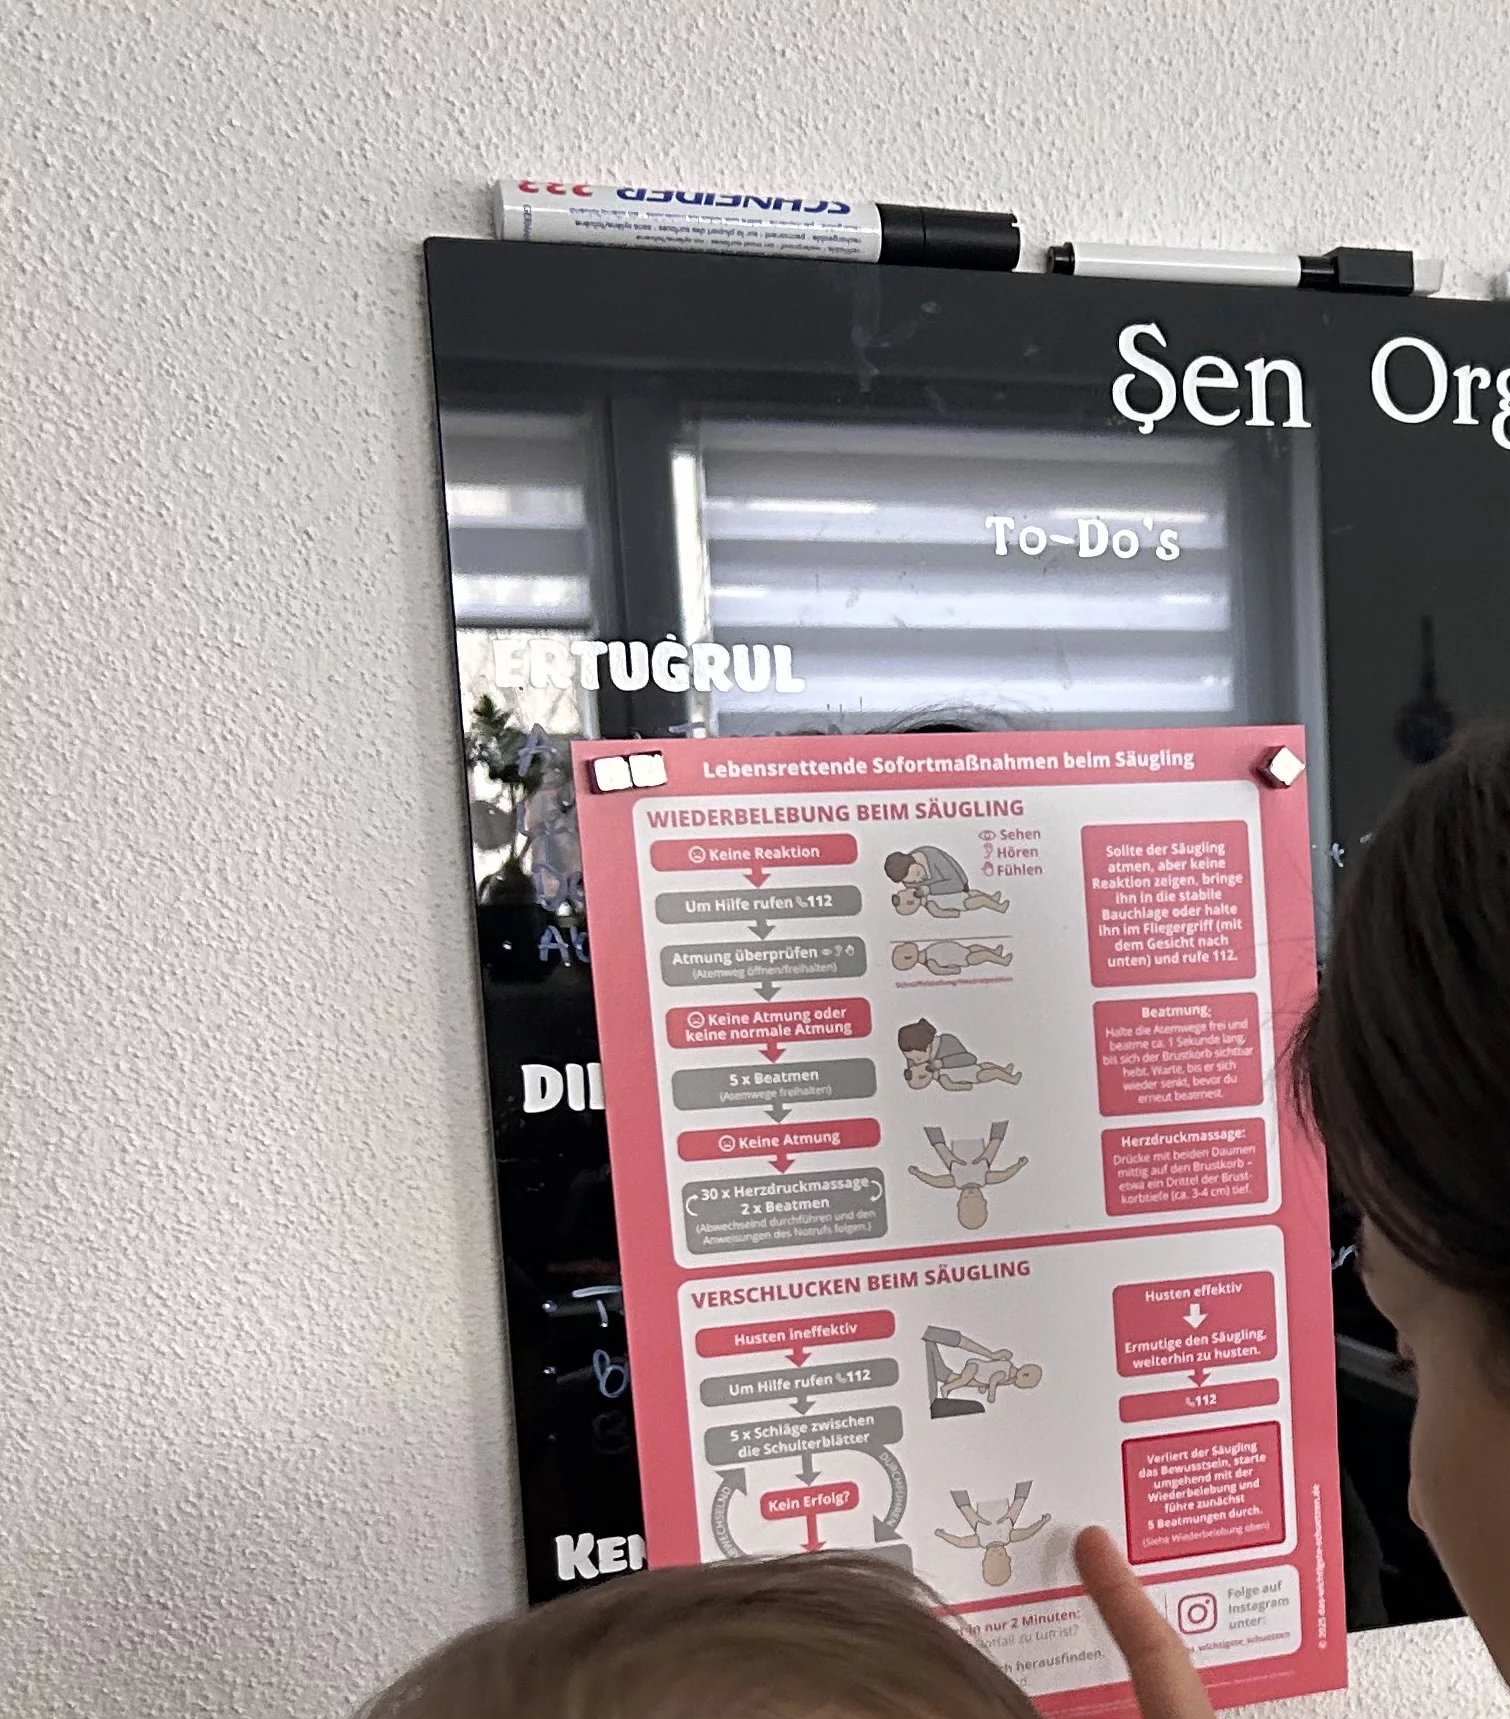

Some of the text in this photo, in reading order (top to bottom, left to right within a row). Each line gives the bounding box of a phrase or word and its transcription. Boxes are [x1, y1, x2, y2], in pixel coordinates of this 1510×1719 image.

[1111, 322, 1313, 435] Şen
[985, 514, 1180, 561] To-Do's
[702, 749, 1195, 779] Lebensrettende Sofortmaßnahmen beim Säugling
[646, 798, 1024, 828] WIEDERBELEBUNG BEIM SÄUGLING
[1000, 828, 1041, 841] Sehen
[709, 845, 821, 862] Keine Reaktion
[997, 846, 1039, 859] Hören
[1106, 842, 1226, 858] Sollte der Säugling
[997, 864, 1043, 876] Fühlen
[1158, 860, 1188, 872] aber
[1190, 858, 1226, 870] keine
[1092, 872, 1243, 890] Reaktion zeigen, bringe
[685, 894, 833, 913] Um Hilfe rufen 112
[1115, 888, 1222, 904] ihn in die stabile
[1102, 903, 1238, 922] Bauchlage oder halte
[1099, 918, 1243, 937] ihn im Fliegergriff (mit
[1115, 935, 1229, 951] dem Gesicht nach
[672, 948, 818, 966] Atmung überprüfen
[1107, 949, 1239, 968] unten) und rufe 112.
[708, 1007, 847, 1027] Keine Atmung oder
[685, 1022, 852, 1042] keine normale Atmung
[1106, 1018, 1249, 1039] Halte die Atemwege frei und
[1109, 1039, 1149, 1052] beatme
[1151, 1040, 1165, 1049] ca.
[1176, 1034, 1220, 1047] Sekunde
[729, 1070, 819, 1086] 5 x Beatmen
[739, 1131, 841, 1149] Keine Atmung
[1121, 1128, 1246, 1149] Herzdruckmassage:
[1113, 1145, 1256, 1166] Drücke mit beiden Daumen
[1118, 1158, 1245, 1178] mittig auf den Brustkorb
[700, 1176, 869, 1200] 30 x Herzdruckmassage
[740, 1198, 829, 1215] 2 x Beatmen
[769, 1212, 832, 1226] durchführen
[834, 1210, 854, 1222] und
[856, 1208, 876, 1220] den
[691, 1260, 1031, 1309] VERSCHLUCKEN BEIM SÄUGLING
[1145, 1282, 1243, 1302] Husten effektiv
[735, 1322, 858, 1347] Husten ineffektiv
[1125, 1328, 1266, 1354] Ermutige den Säugling,
[1132, 1345, 1260, 1369] weiterhin zu husten.
[728, 1369, 872, 1397] Um Hilfe rufen 112
[1195, 1393, 1217, 1407] 112
[730, 1415, 875, 1442] 5 x Schläge zwischen
[738, 1432, 870, 1458] die Schulterblätter
[1146, 1442, 1258, 1465] Verliert der Säugling
[1138, 1467, 1158, 1479] das
[1234, 1453, 1267, 1466] starte
[1153, 1467, 1254, 1490] umgehend mit der
[878, 1452, 906, 1527] DURCHFÜHREN
[1148, 1478, 1260, 1503] Wiederbelebung und
[769, 1490, 851, 1512] Kein Erfolg?
[1164, 1493, 1246, 1514] führe zunächst
[715, 1486, 740, 1559] BWECHSELND
[1157, 1511, 1226, 1529] Beatmungen
[1229, 1505, 1263, 1518] durch.
[1227, 1580, 1283, 1599] Folge auf
[1228, 1596, 1290, 1614] Instagram
[985, 1609, 1081, 1633] nur 2 Minuten:
[1016, 1649, 1106, 1673] herausfinden.
